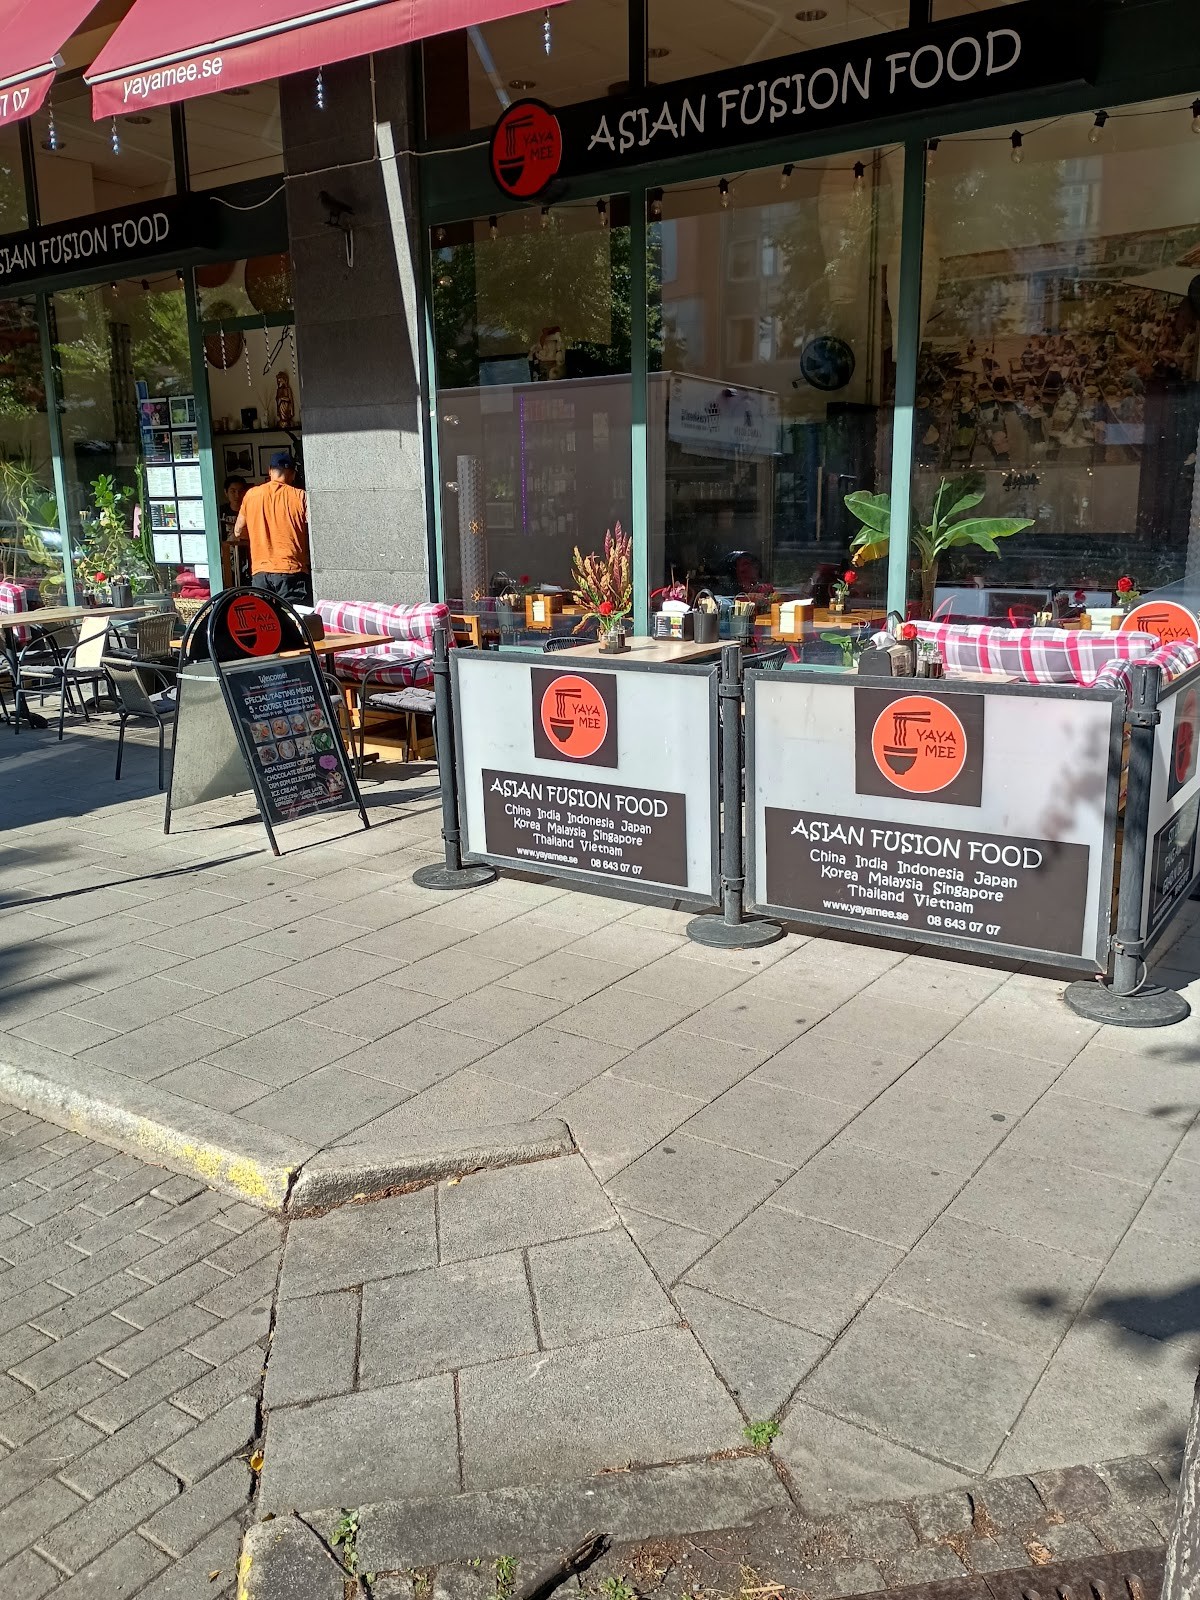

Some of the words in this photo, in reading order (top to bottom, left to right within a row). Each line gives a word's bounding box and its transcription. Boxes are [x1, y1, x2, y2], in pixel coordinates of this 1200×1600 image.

[123, 57, 223, 103] yayamee.se
[587, 95, 706, 154] ASIAN
[717, 57, 873, 128] FUSION
[886, 28, 1021, 95] FOOD
[13, 87, 30, 112] 07
[523, 131, 554, 146] YAYA
[530, 146, 554, 160] MEE
[40, 225, 108, 265] FUSION
[111, 212, 169, 249] FOOD
[251, 613, 274, 623] YAYA
[259, 623, 277, 632] MEE
[1157, 627, 1191, 638] YAYA
[244, 694, 270, 706] SPECIAL
[270, 689, 296, 701] TASTING
[296, 685, 314, 696] MENU
[249, 705, 255, 714] 5
[258, 701, 283, 713] COURSE
[283, 695, 315, 708] SELECTION
[572, 703, 601, 717] YAYA
[579, 717, 601, 729] MEE
[916, 728, 957, 745] YAYA
[925, 745, 957, 760] MEE
[490, 777, 543, 801] ASIAN
[546, 785, 611, 811] FUSION
[615, 794, 668, 818] FOOD
[504, 803, 531, 818] China
[537, 807, 561, 822] India
[567, 811, 615, 830] Indonesia
[620, 820, 652, 835] Japan
[513, 817, 541, 831] Korea
[547, 822, 587, 839] Malaysia
[593, 829, 643, 847] Singapore
[791, 819, 865, 847] ASIAN
[870, 829, 961, 861] FUSION
[968, 841, 1043, 870] FOOD
[533, 833, 574, 849] Thailand
[579, 840, 623, 857] Vietnam
[516, 847, 578, 864] www.yayamee.se
[591, 858, 602, 868] 08
[603, 859, 619, 871] 643
[620, 862, 631, 873] 07
[632, 864, 643, 875] 07
[810, 849, 847, 867] China
[855, 854, 888, 871] India
[897, 860, 965, 882] Indonesia
[973, 871, 1018, 889] Japan
[821, 865, 859, 882] Korea
[868, 872, 923, 893] Malaysia
[933, 881, 1004, 902] Singapore
[847, 884, 905, 904] Thailand
[913, 893, 974, 914] Vietnam
[822, 899, 909, 922] www.yayamee.se
[927, 914, 942, 927] 08
[944, 916, 967, 931] 643
[969, 919, 985, 933] 07
[985, 922, 1001, 936] 07
